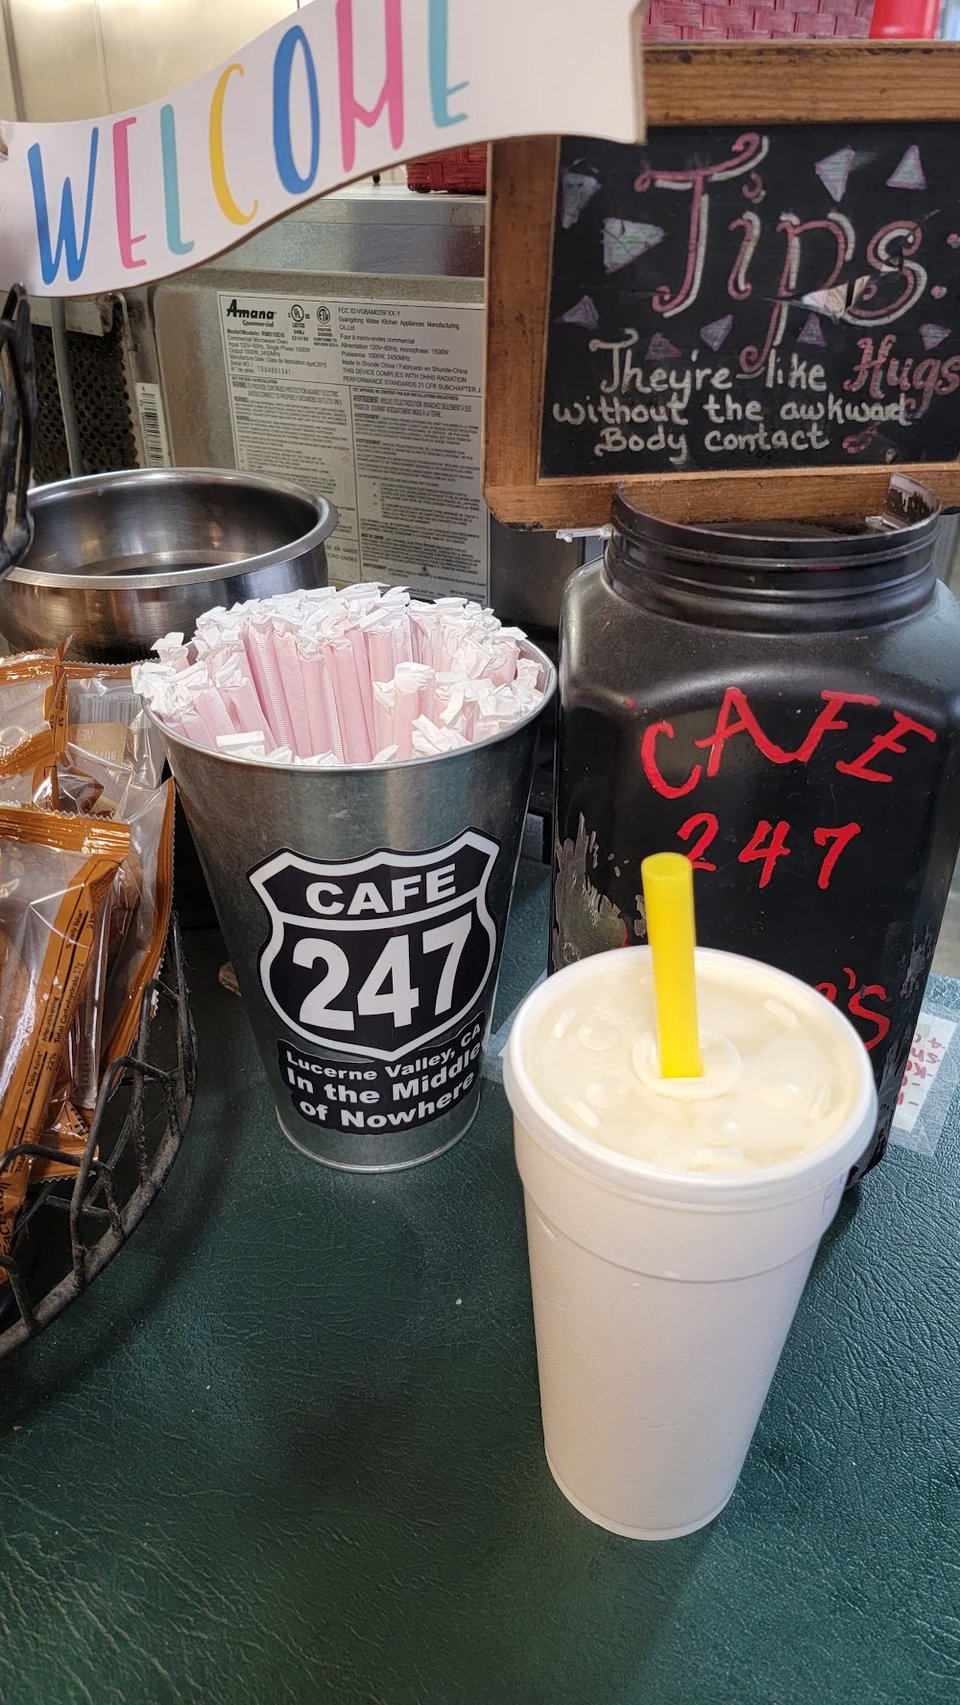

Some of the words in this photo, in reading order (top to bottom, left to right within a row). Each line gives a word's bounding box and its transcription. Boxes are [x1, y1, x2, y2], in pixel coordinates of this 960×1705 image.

[27, 0, 470, 285] WELCOME
[226, 299, 275, 320] Amana
[242, 319, 274, 328] Commercial
[400, 320, 425, 328] Appliances
[427, 321, 460, 331] Manufacturing
[343, 375, 383, 384] PERFORMANCE
[384, 379, 417, 388] STANDARDS
[437, 383, 477, 392] SUBCHAPTER
[376, 370, 403, 378] COMPLIES
[436, 374, 467, 383] RADIATION
[381, 361, 395, 369] China
[399, 363, 423, 371] Fabricado
[431, 365, 468, 375] Shunde-China
[765, 349, 826, 393] like
[843, 334, 960, 420] Hugs
[552, 394, 688, 426] without
[703, 393, 763, 424] the
[594, 427, 688, 465] Body
[704, 425, 830, 454] contact
[640, 686, 938, 800] CAFE
[305, 863, 456, 916] CAFE
[292, 911, 472, 1032] 247
[54, 1025, 65, 1043] Total
[60, 977, 80, 1025] Carbohydrate
[286, 1050, 378, 1081] Lucerne
[385, 1047, 456, 1079] Valley,
[460, 1022, 481, 1048] CA
[287, 1067, 314, 1094] In
[323, 1084, 381, 1105] the
[392, 1041, 482, 1103] Middle
[300, 1099, 328, 1122] of
[340, 1070, 475, 1129] Nowhere
